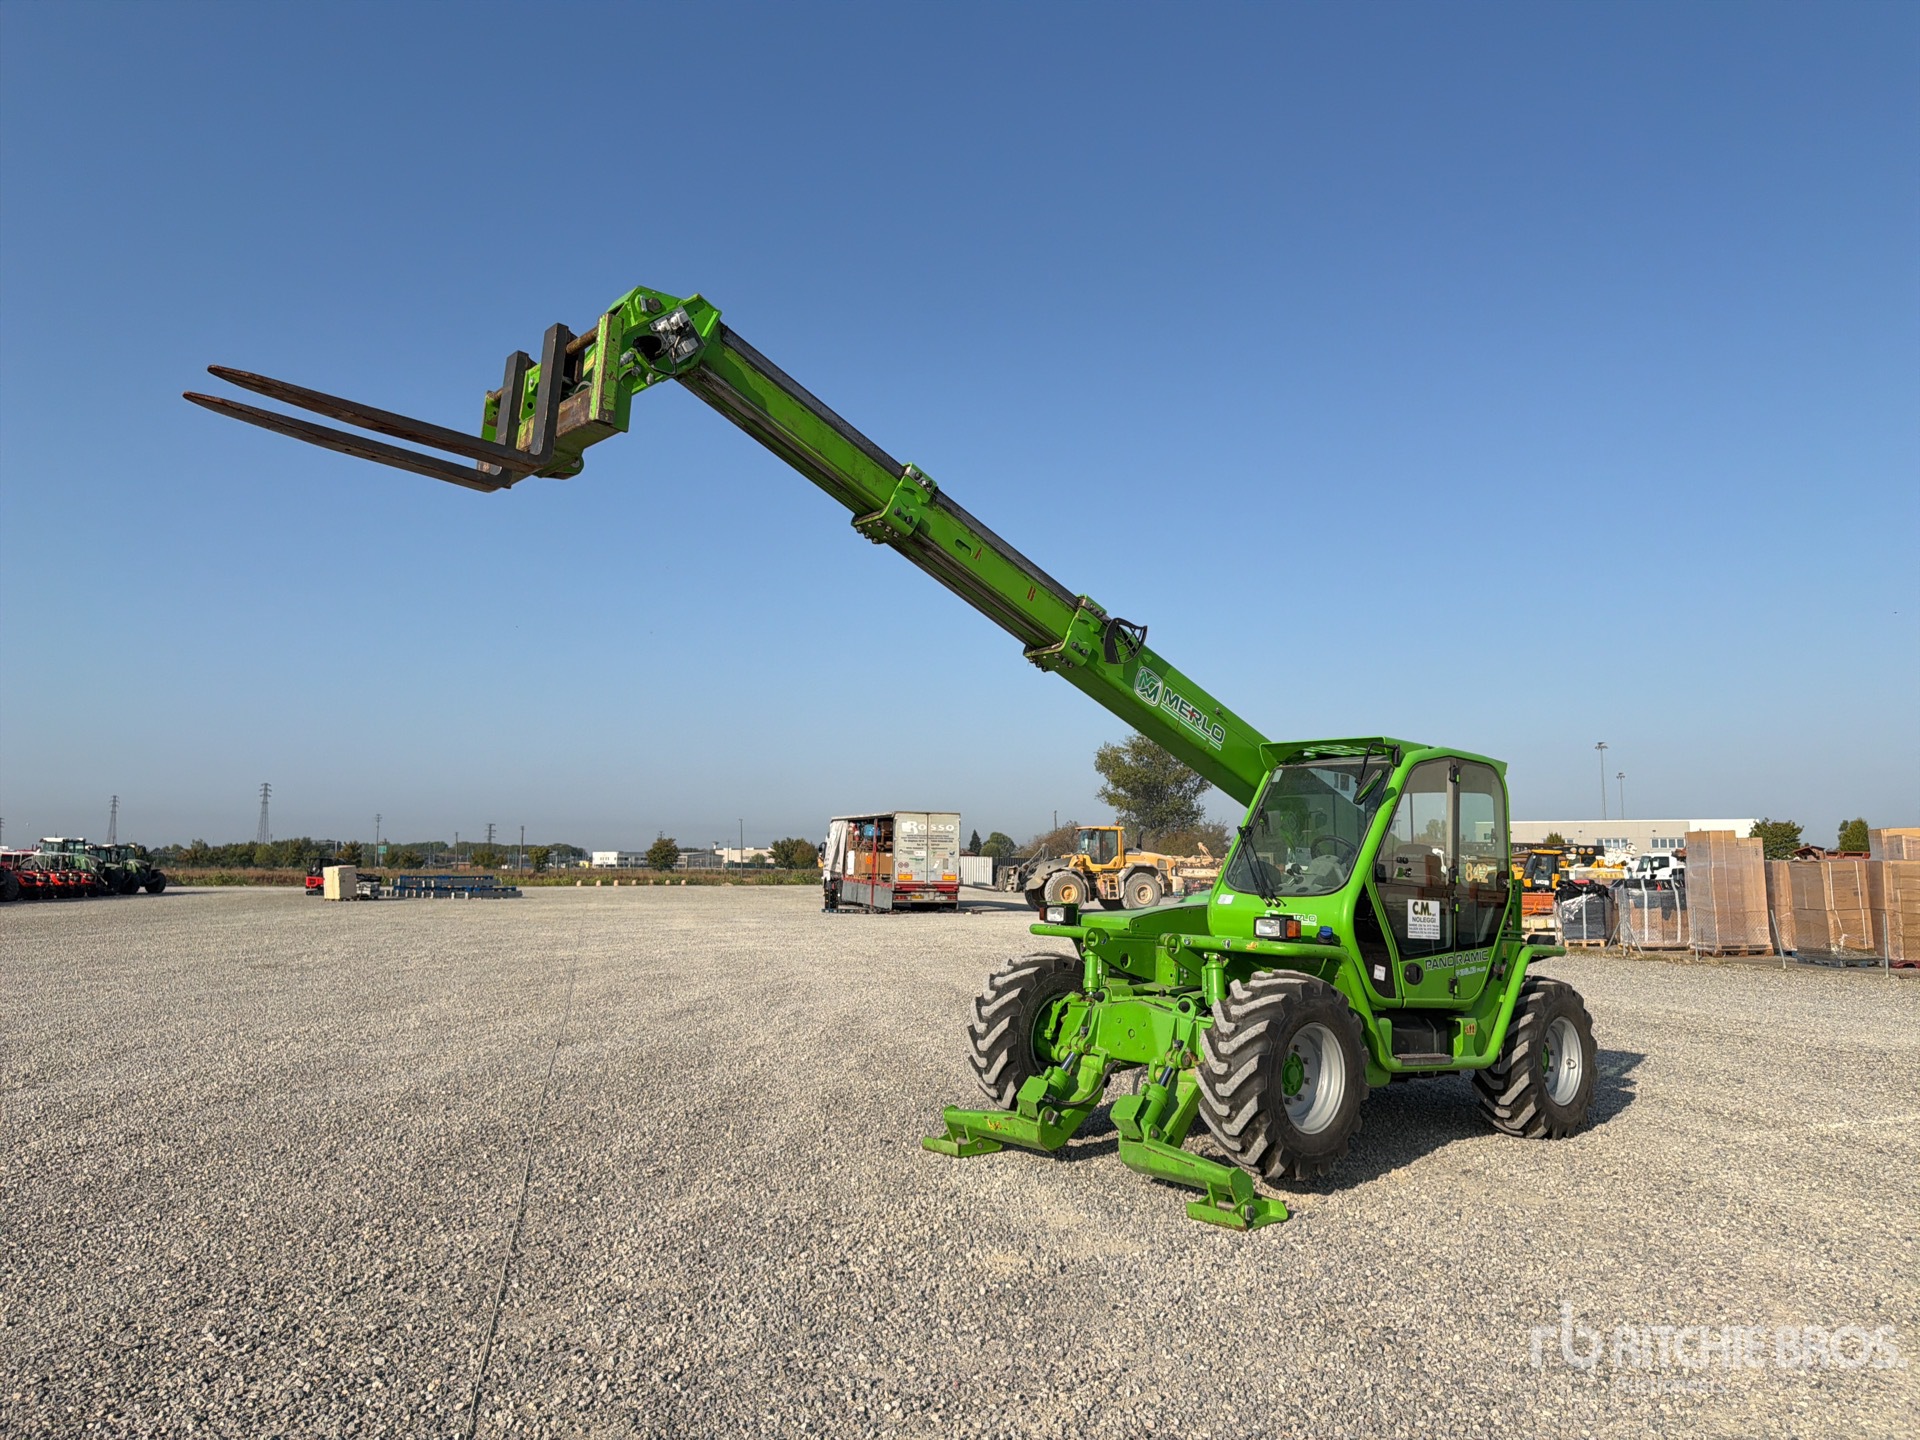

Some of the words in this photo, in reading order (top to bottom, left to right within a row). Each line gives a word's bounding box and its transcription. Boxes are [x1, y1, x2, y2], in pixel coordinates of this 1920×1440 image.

[1163, 686, 1226, 744] MERLO
[1465, 862, 1488, 884] 842
[1412, 901, 1432, 917] C.M.
[1425, 950, 1489, 971] PANORAMIC
